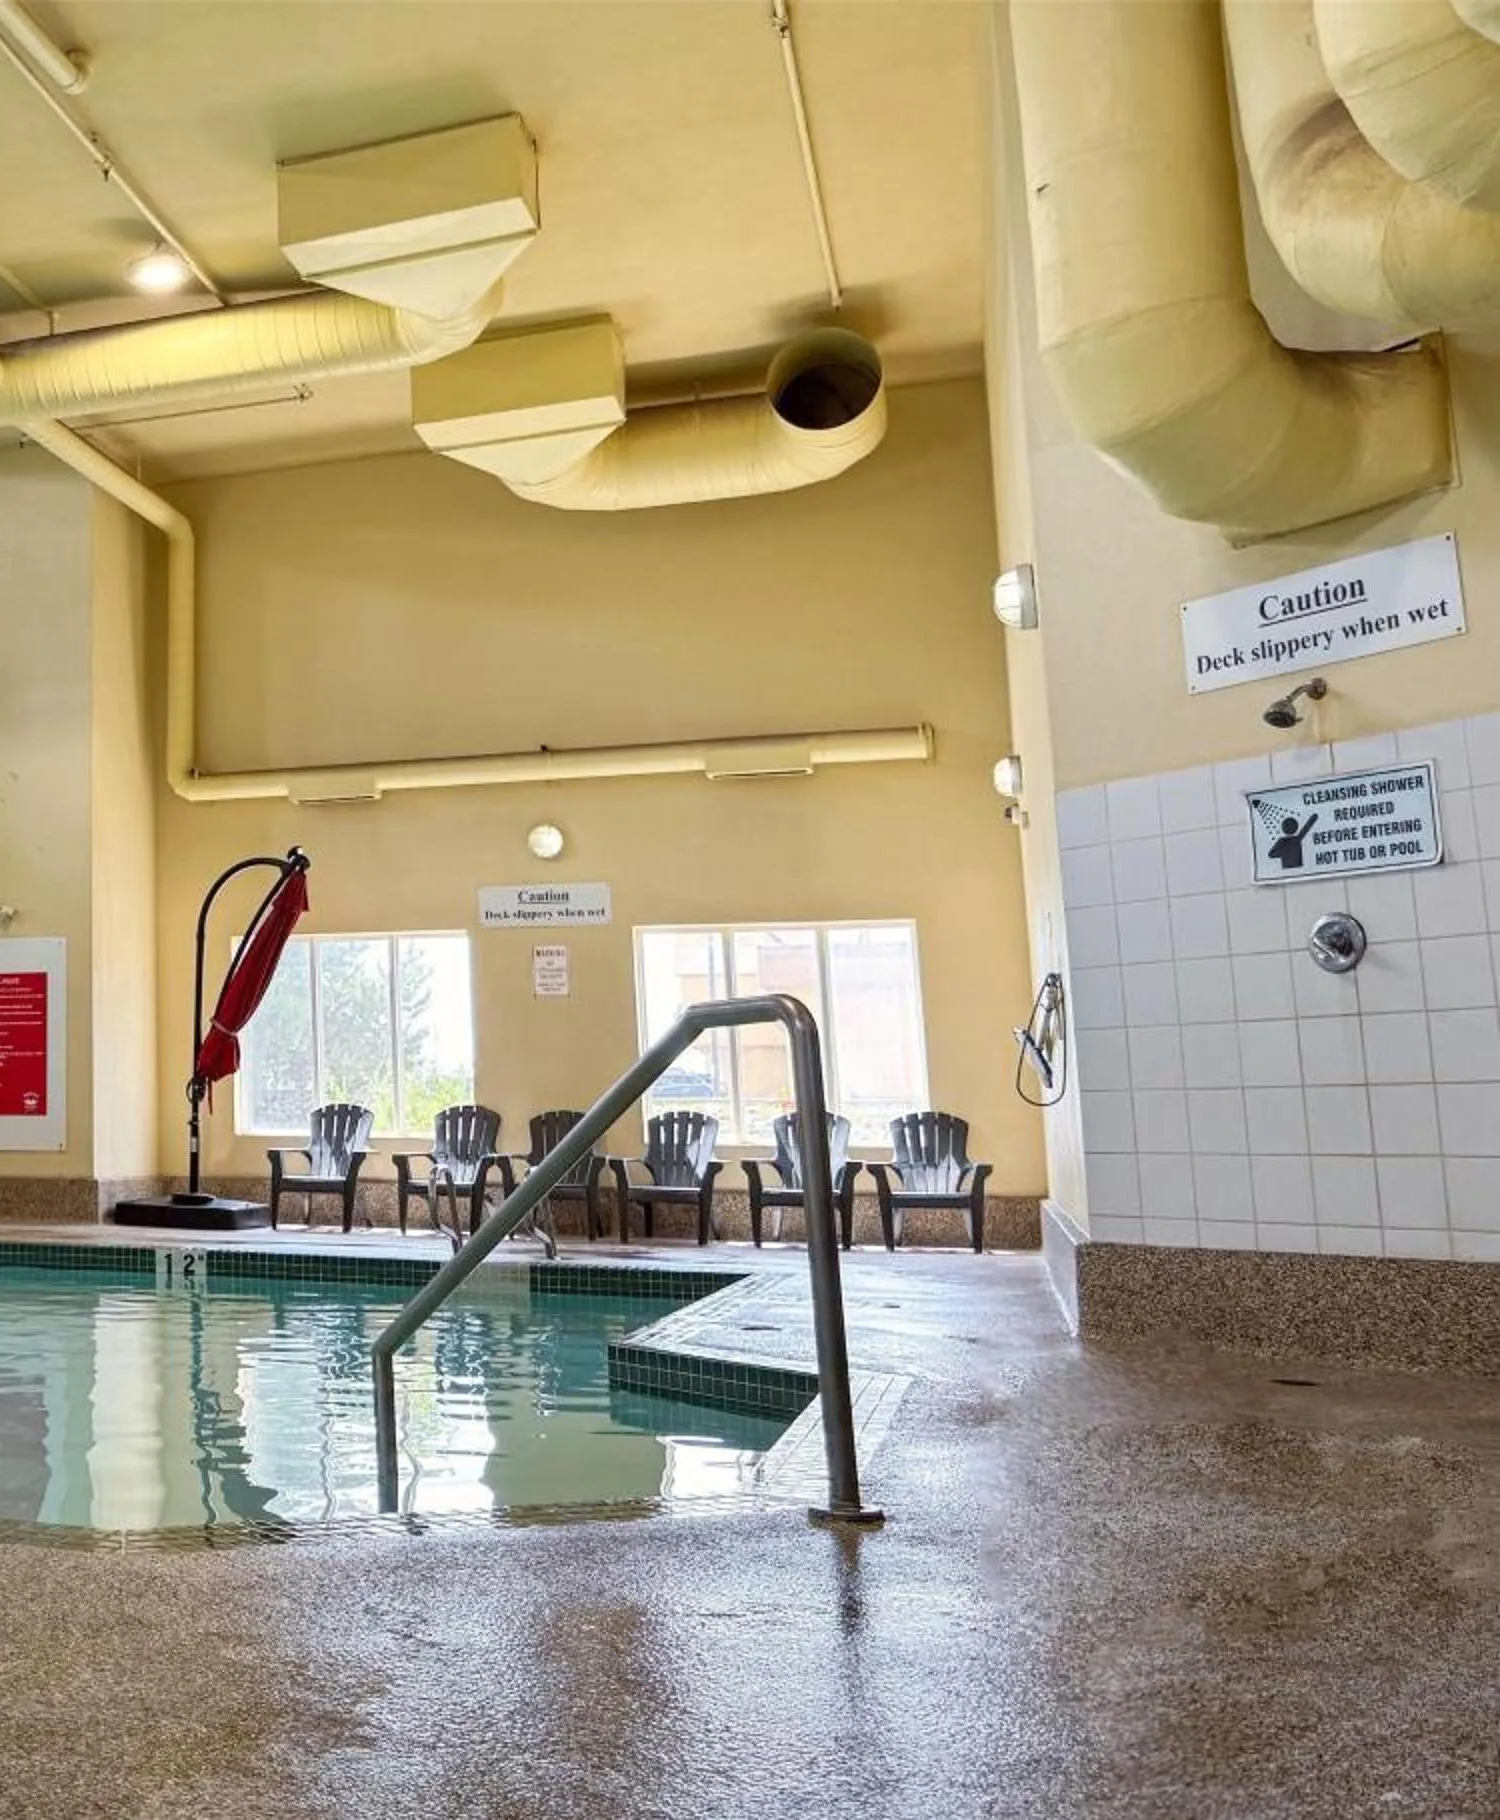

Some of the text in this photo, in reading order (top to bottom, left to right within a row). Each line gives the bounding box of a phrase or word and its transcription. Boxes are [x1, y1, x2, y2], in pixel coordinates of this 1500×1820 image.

[1259, 578, 1366, 622] Caution
[1196, 599, 1450, 675] Deck slippery when wet
[1302, 775, 1424, 806] CLEANSING SHOWER
[1334, 801, 1395, 822] REQUIRED
[1312, 819, 1423, 846] BEFORE ENTERING
[1315, 841, 1424, 865] HOT TUB OR POOL
[517, 888, 570, 902] Caution
